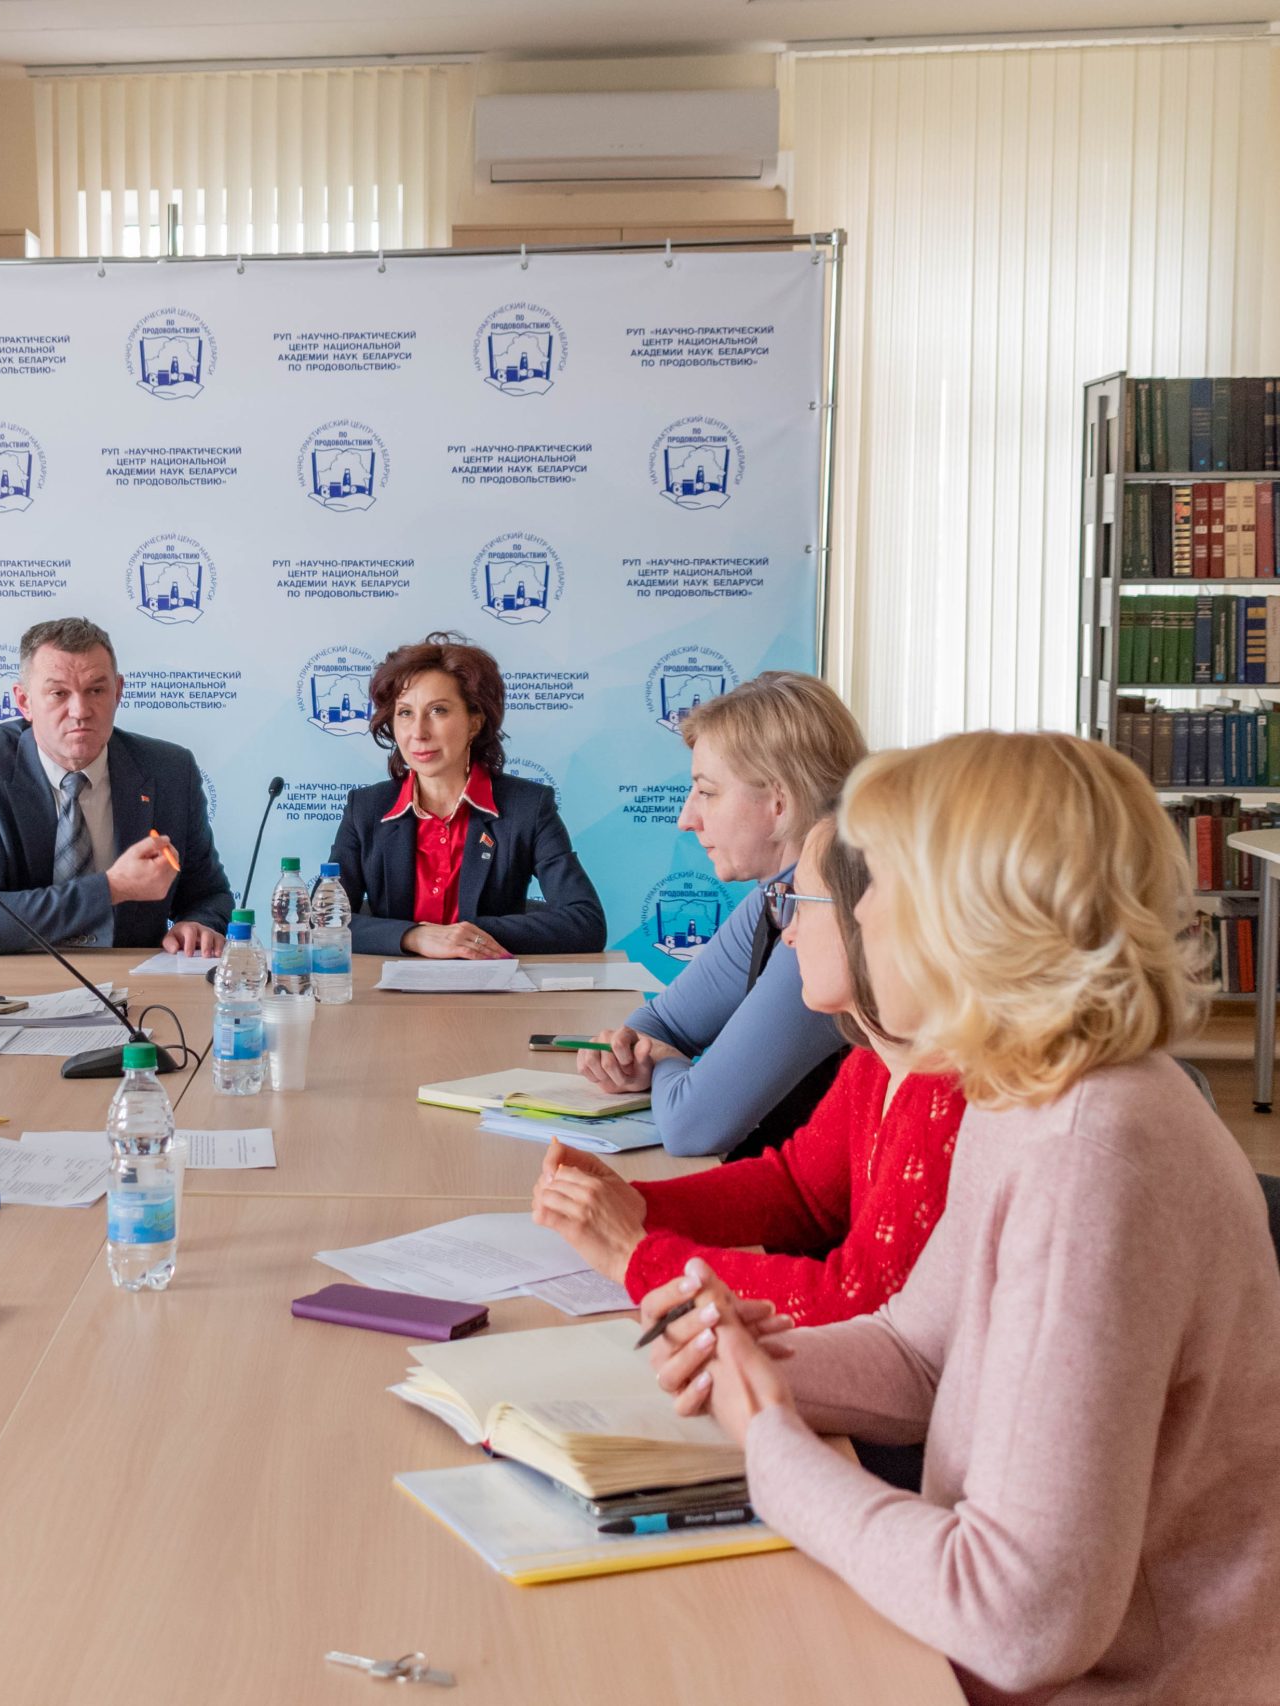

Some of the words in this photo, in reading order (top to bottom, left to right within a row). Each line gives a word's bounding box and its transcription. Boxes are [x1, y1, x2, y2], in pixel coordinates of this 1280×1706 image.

[626, 327, 646, 337] РУП
[274, 332, 292, 342] РУП
[642, 337, 674, 347] ЦЕНТР
[678, 336, 758, 346] НАЦИОНАЛЬНОЙ
[288, 342, 320, 352] ЦЕНТР
[322, 341, 400, 351] НАЦИОНАЛЬНОЙ
[278, 352, 328, 362] АКАДЕМИИ
[332, 352, 358, 361] НАУК
[362, 351, 412, 361] БЕЛАРУСИ
[630, 348, 684, 358] АКАДЕМИИ
[688, 347, 714, 357] НАУК
[718, 346, 770, 356] БЕЛАРУСИ
[18, 356, 66, 364] БЕЛАРУСИ
[640, 359, 656, 368] ПО
[288, 363, 302, 372] ПО
[102, 447, 120, 456] РУП
[448, 444, 466, 453] РУП
[116, 457, 146, 466] ЦЕНТР
[150, 456, 226, 466] НАЦИОНАЛЬНОЙ
[462, 455, 494, 464] ЦЕНТР
[498, 454, 576, 464] НАЦИОНАЛЬНОЙ
[106, 467, 156, 476] АКАДЕМИИ
[160, 467, 184, 476] НАУК
[188, 467, 238, 476] БЕЛАРУСИ
[452, 465, 504, 474] АКАДЕМИИ
[508, 465, 532, 474] НАУК
[536, 465, 588, 474] БЕЛАРУСИ
[116, 477, 130, 486] ПО
[462, 475, 476, 484] ПО
[272, 559, 290, 568] РУП
[622, 558, 642, 567] РУП
[288, 569, 318, 578] ЦЕНТР
[322, 568, 398, 578] НАЦИОНАЛЬНОЙ
[638, 568, 670, 577] ЦЕНТР
[672, 568, 752, 577] НАЦИОНАЛЬНОЙ
[20, 579, 66, 588] БЕЛАРУСИ
[276, 579, 328, 588] АКАДЕМИИ
[332, 579, 356, 588] НАУК
[360, 579, 410, 588] БЕЛАРУСИ
[626, 578, 678, 587] АКАДЕМИИ
[682, 578, 708, 587] НАУК
[712, 578, 764, 587] БЕЛАРУСИ
[286, 589, 300, 598] ПО
[636, 588, 652, 597] ПО
[124, 681, 146, 689] ЕНТР
[151, 680, 226, 690] НАЦИОНАЛЬНОЙ
[160, 691, 184, 699] НАУК
[189, 691, 237, 699] БЕЛАРУСИ
[534, 692, 584, 700] БЕЛАРУСИ
[287, 793, 316, 801] ЦЕНТР
[276, 803, 326, 811] АКАДЕМИИ
[623, 805, 675, 814] АКАДЕМИИ
